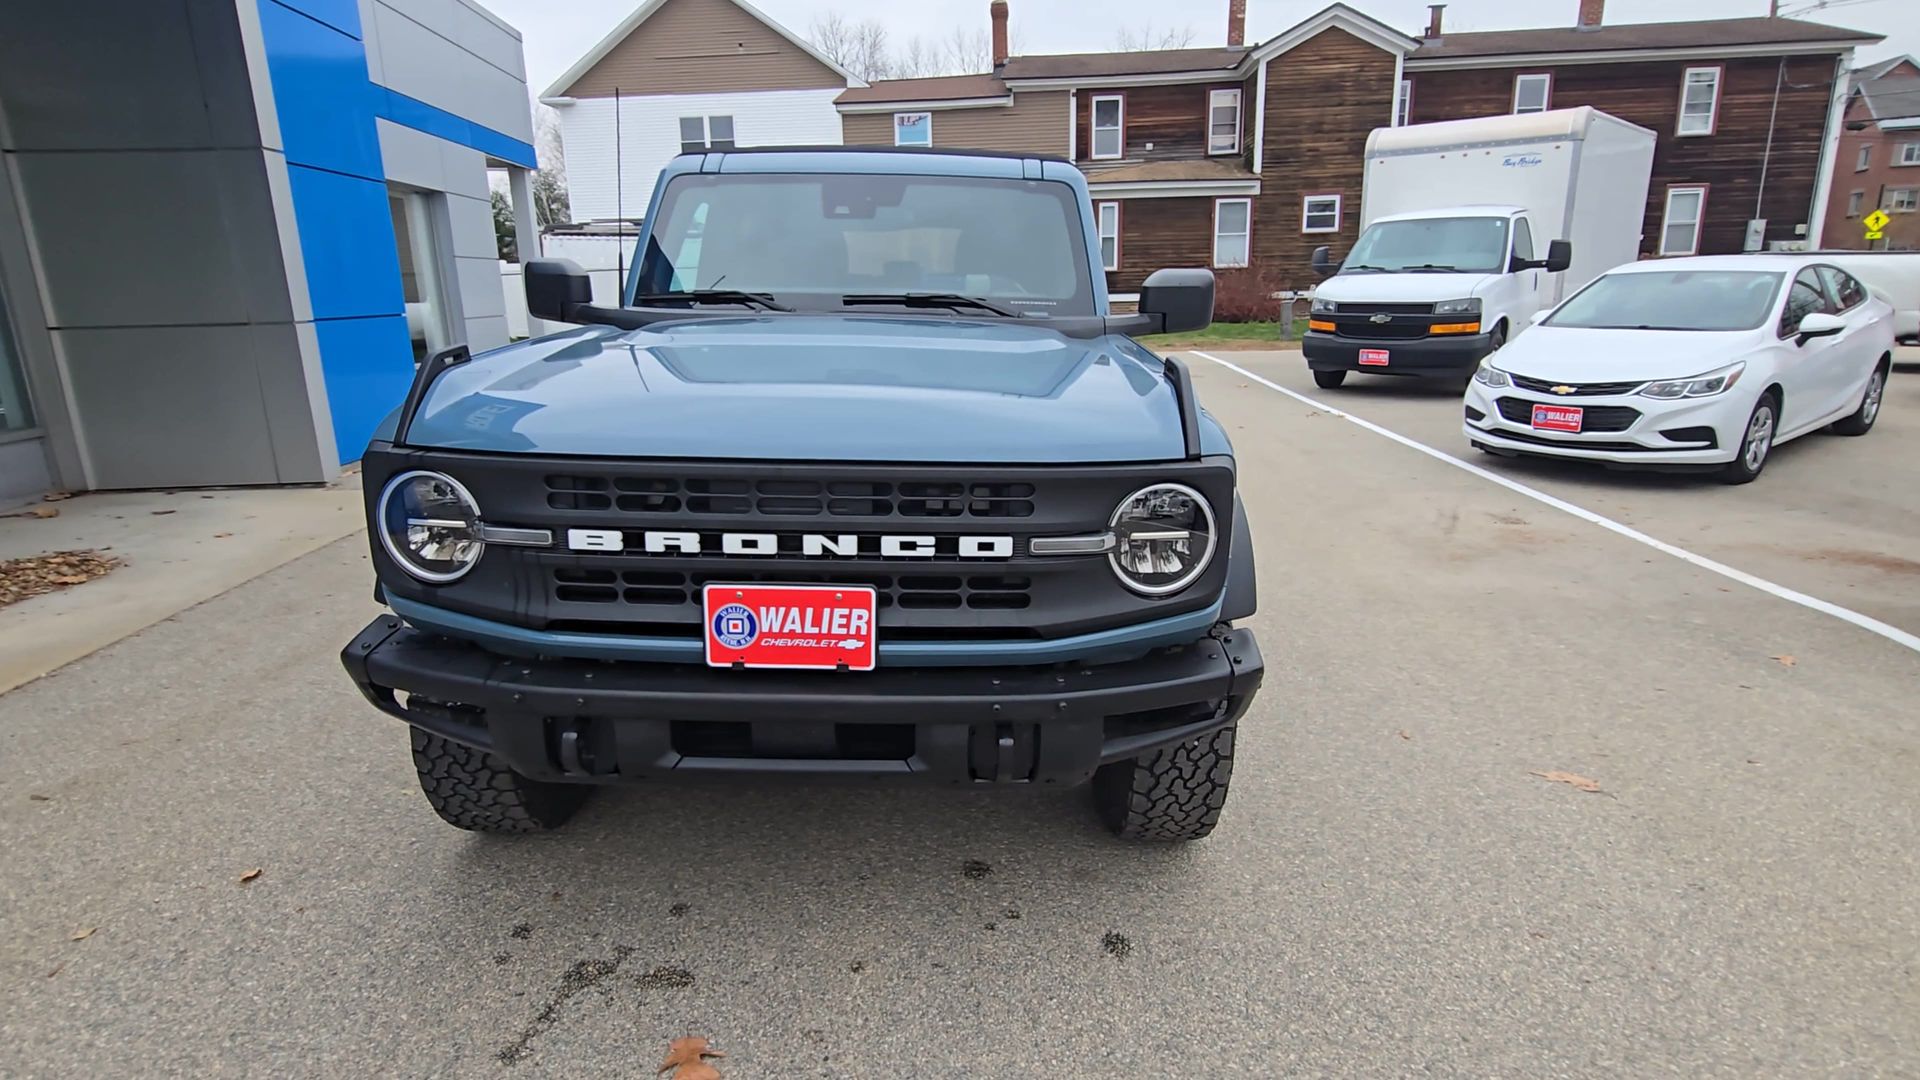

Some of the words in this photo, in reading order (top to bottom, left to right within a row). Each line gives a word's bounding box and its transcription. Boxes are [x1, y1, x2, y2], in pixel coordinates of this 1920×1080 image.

[1547, 411, 1580, 422] WALIER
[568, 529, 1013, 556] BRONCO
[760, 606, 869, 635] WALIER
[761, 638, 836, 648] CHEVROLET
